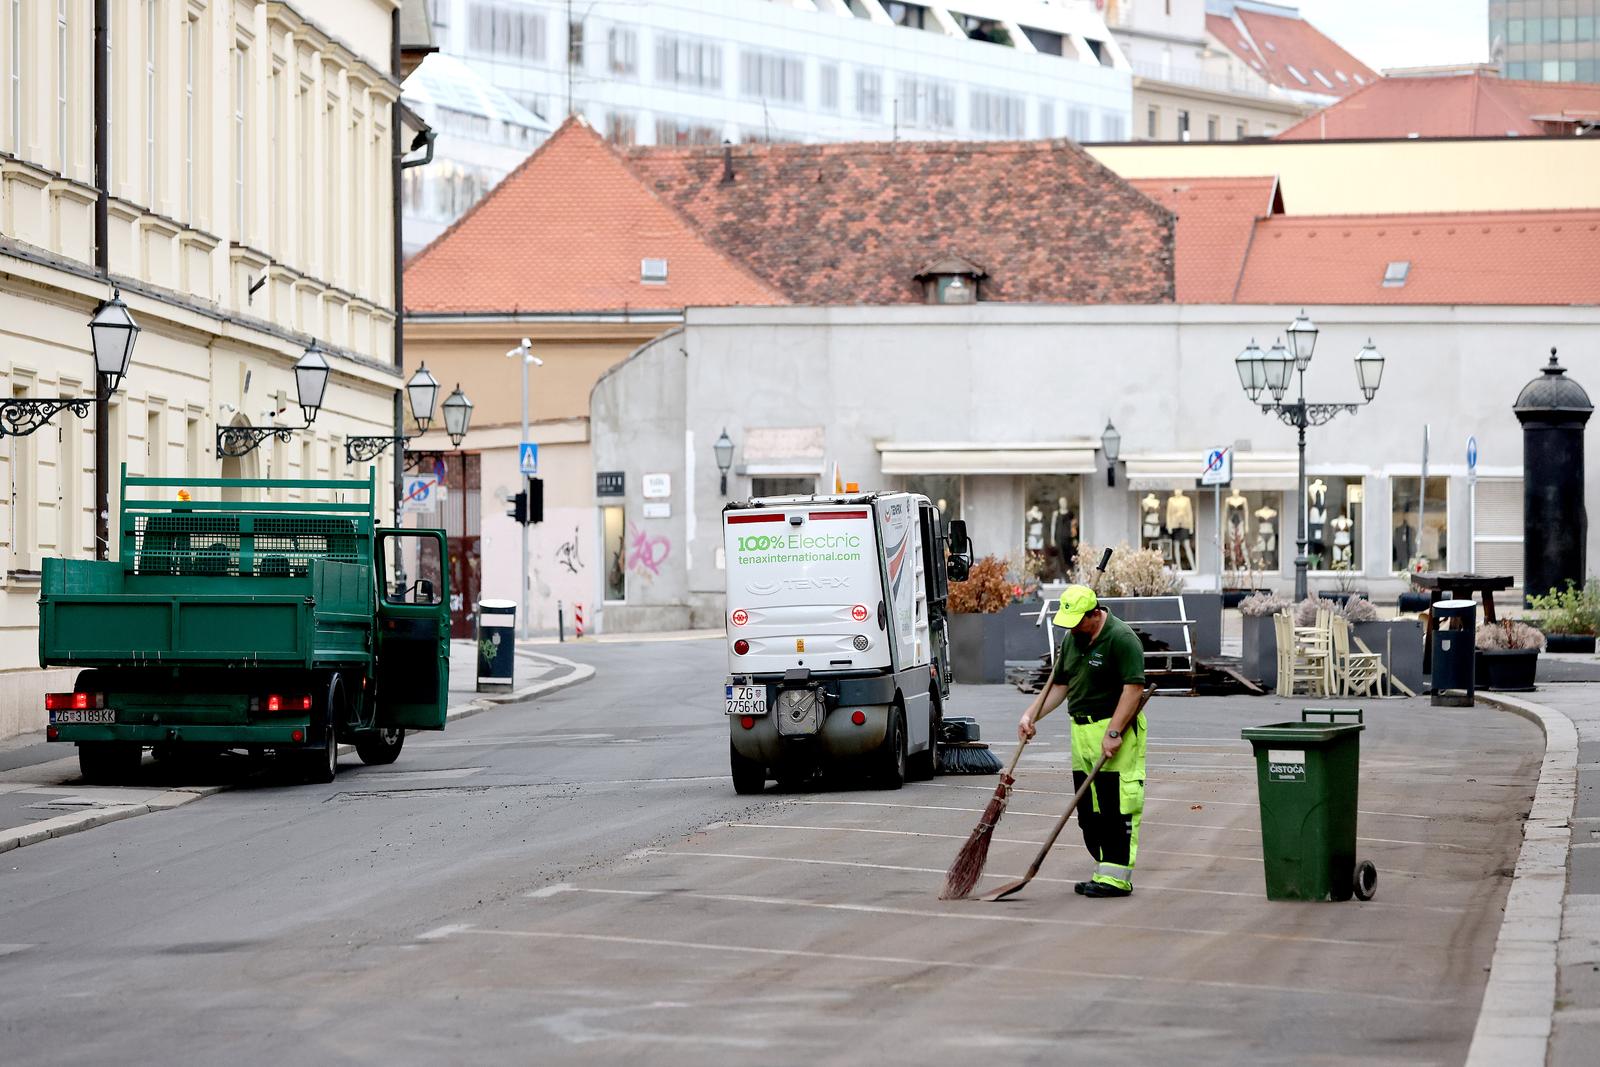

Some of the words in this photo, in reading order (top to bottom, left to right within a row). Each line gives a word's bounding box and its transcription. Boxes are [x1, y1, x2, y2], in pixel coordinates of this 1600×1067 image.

[738, 535, 785, 551] 100%
[788, 532, 860, 549] Electric
[738, 552, 861, 565] tenaxinternational.com
[738, 687, 753, 700] ZG
[57, 710, 69, 721] ZG
